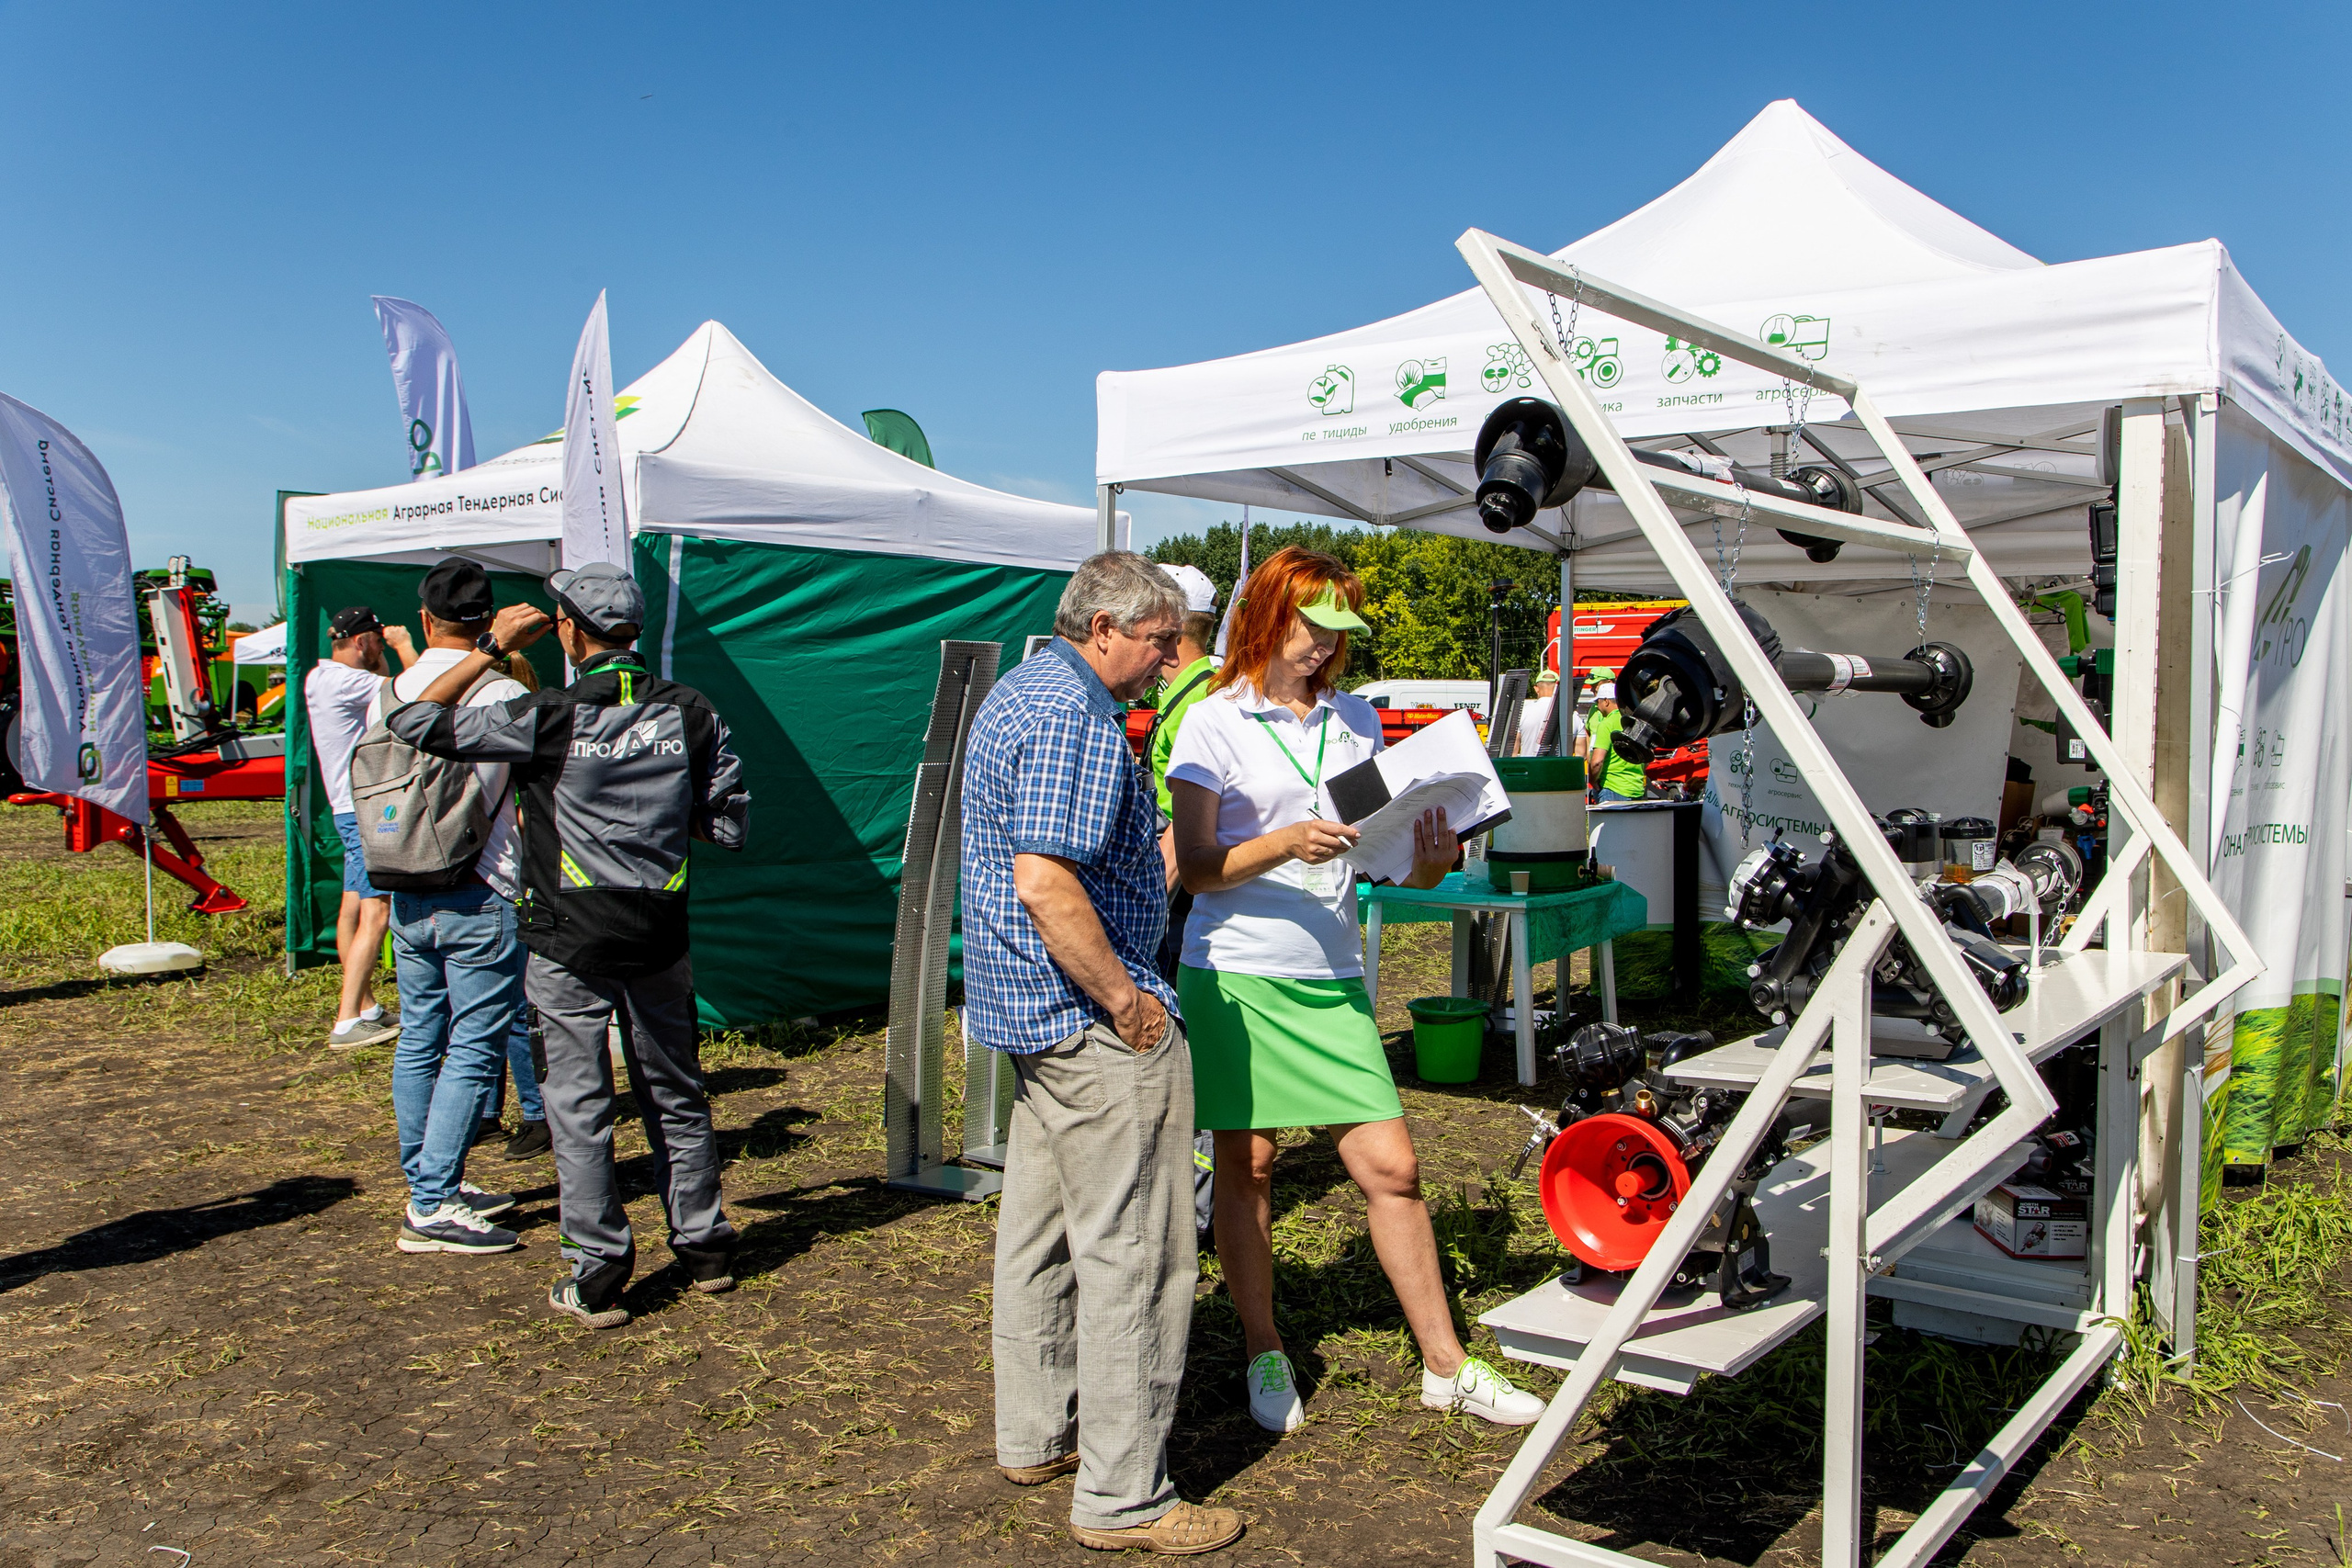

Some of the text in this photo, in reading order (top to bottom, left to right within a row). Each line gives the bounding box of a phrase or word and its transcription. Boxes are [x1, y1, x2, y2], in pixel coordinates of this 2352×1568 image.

[1657, 393, 1723, 408] запчасти
[1756, 386, 1832, 401] агросерв
[1389, 416, 1458, 435] удобрения
[1302, 426, 1367, 441] петициды
[307, 508, 388, 531] Национальная
[393, 501, 453, 521] Аграрная
[458, 489, 534, 513] Тендерная
[1768, 789, 1802, 799] агросервис
[2018, 1206, 2050, 1214] STAR
